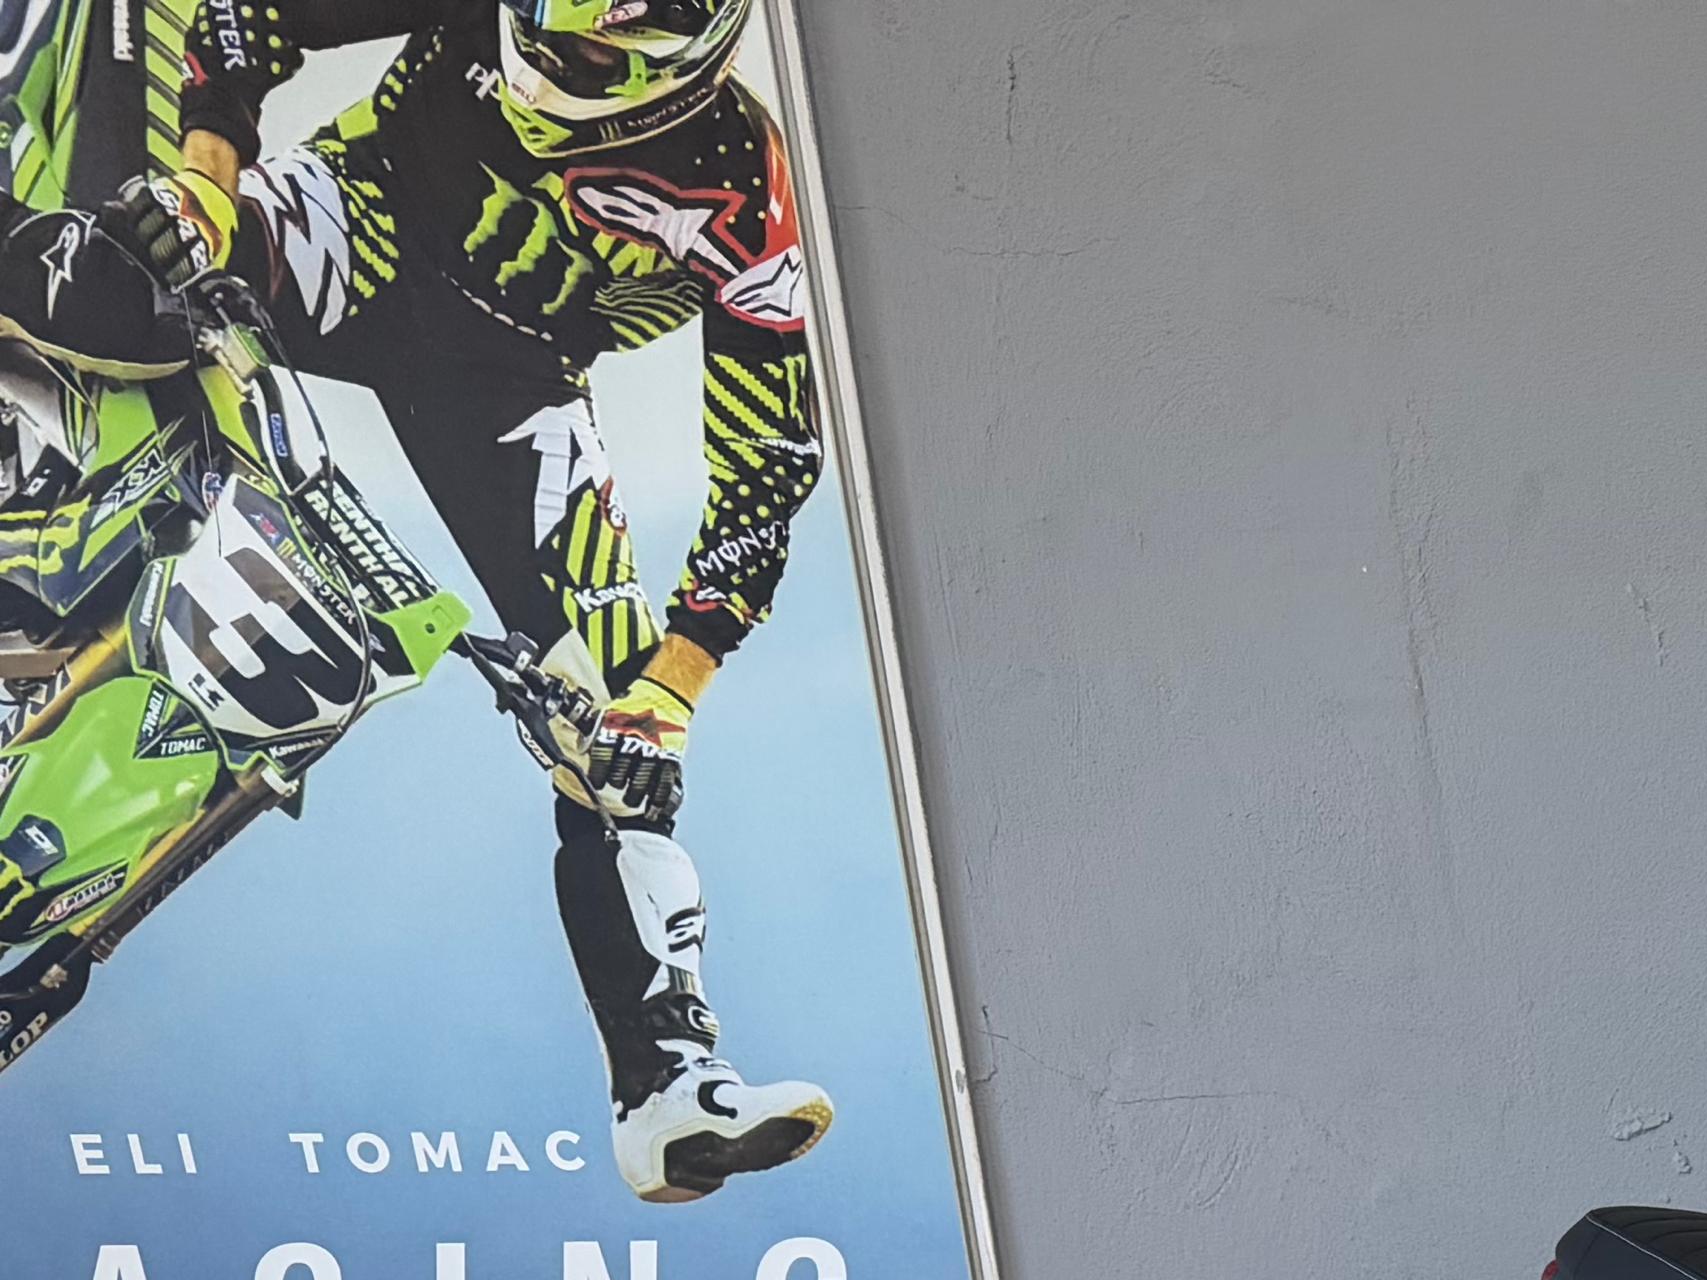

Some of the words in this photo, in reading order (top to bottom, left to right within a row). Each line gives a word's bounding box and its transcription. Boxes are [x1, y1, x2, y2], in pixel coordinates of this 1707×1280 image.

[159, 737, 206, 755] TOMAC
[70, 1132, 197, 1175] ELI
[288, 1130, 587, 1174] TOMAC
